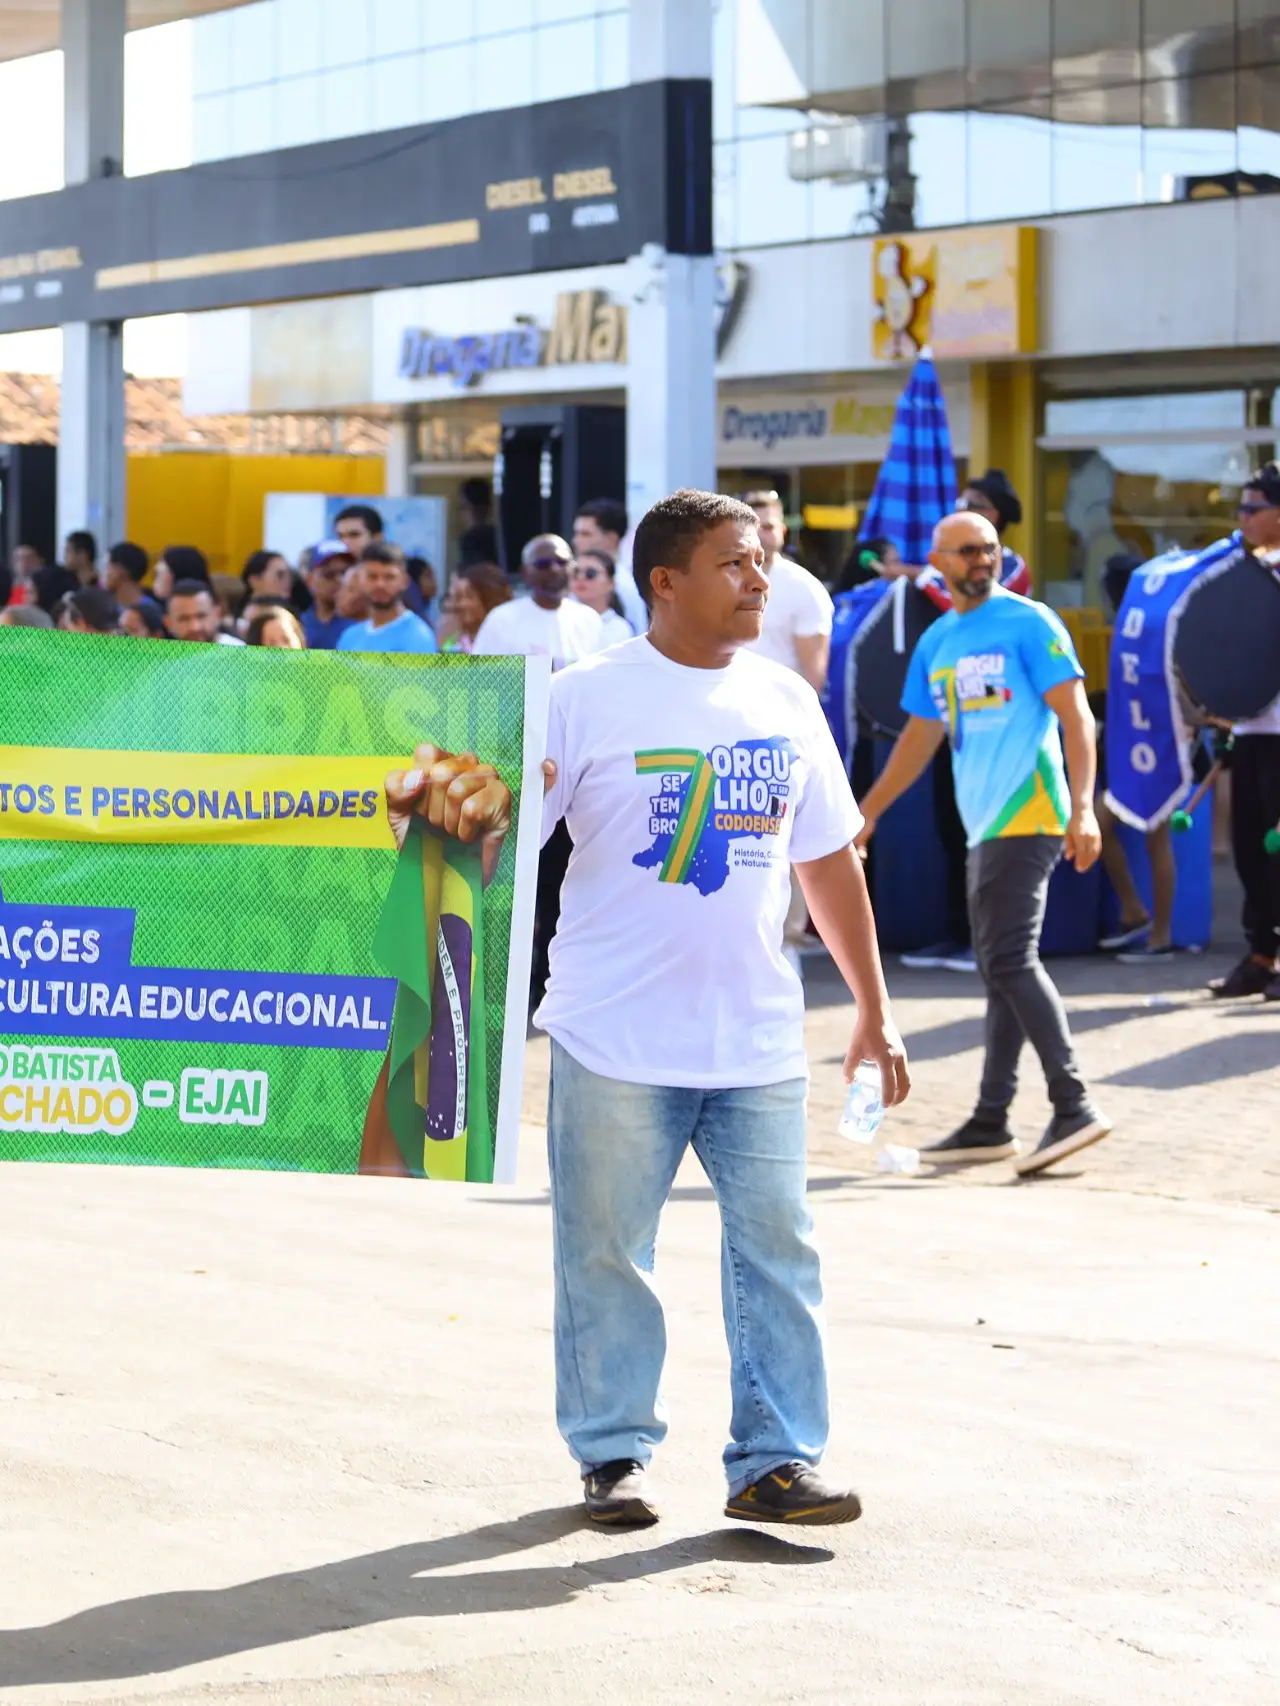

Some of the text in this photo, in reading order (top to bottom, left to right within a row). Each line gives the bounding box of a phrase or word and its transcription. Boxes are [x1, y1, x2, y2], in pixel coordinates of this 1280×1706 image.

[546, 290, 628, 366] Ma
[711, 745, 790, 782] ORGU
[662, 775, 681, 793] SE
[714, 779, 769, 813] LHO
[65, 785, 83, 816] E
[92, 786, 379, 820] PERSONALIDADES
[651, 796, 680, 815] TEM
[650, 816, 678, 835] BRO
[139, 984, 388, 1031] EDUCACIONAL.
[12, 1050, 118, 1083] BATISTA
[448, 989, 458, 1000] E
[453, 1009, 466, 1132] PROGRESSO
[185, 1077, 262, 1118] EJAI
